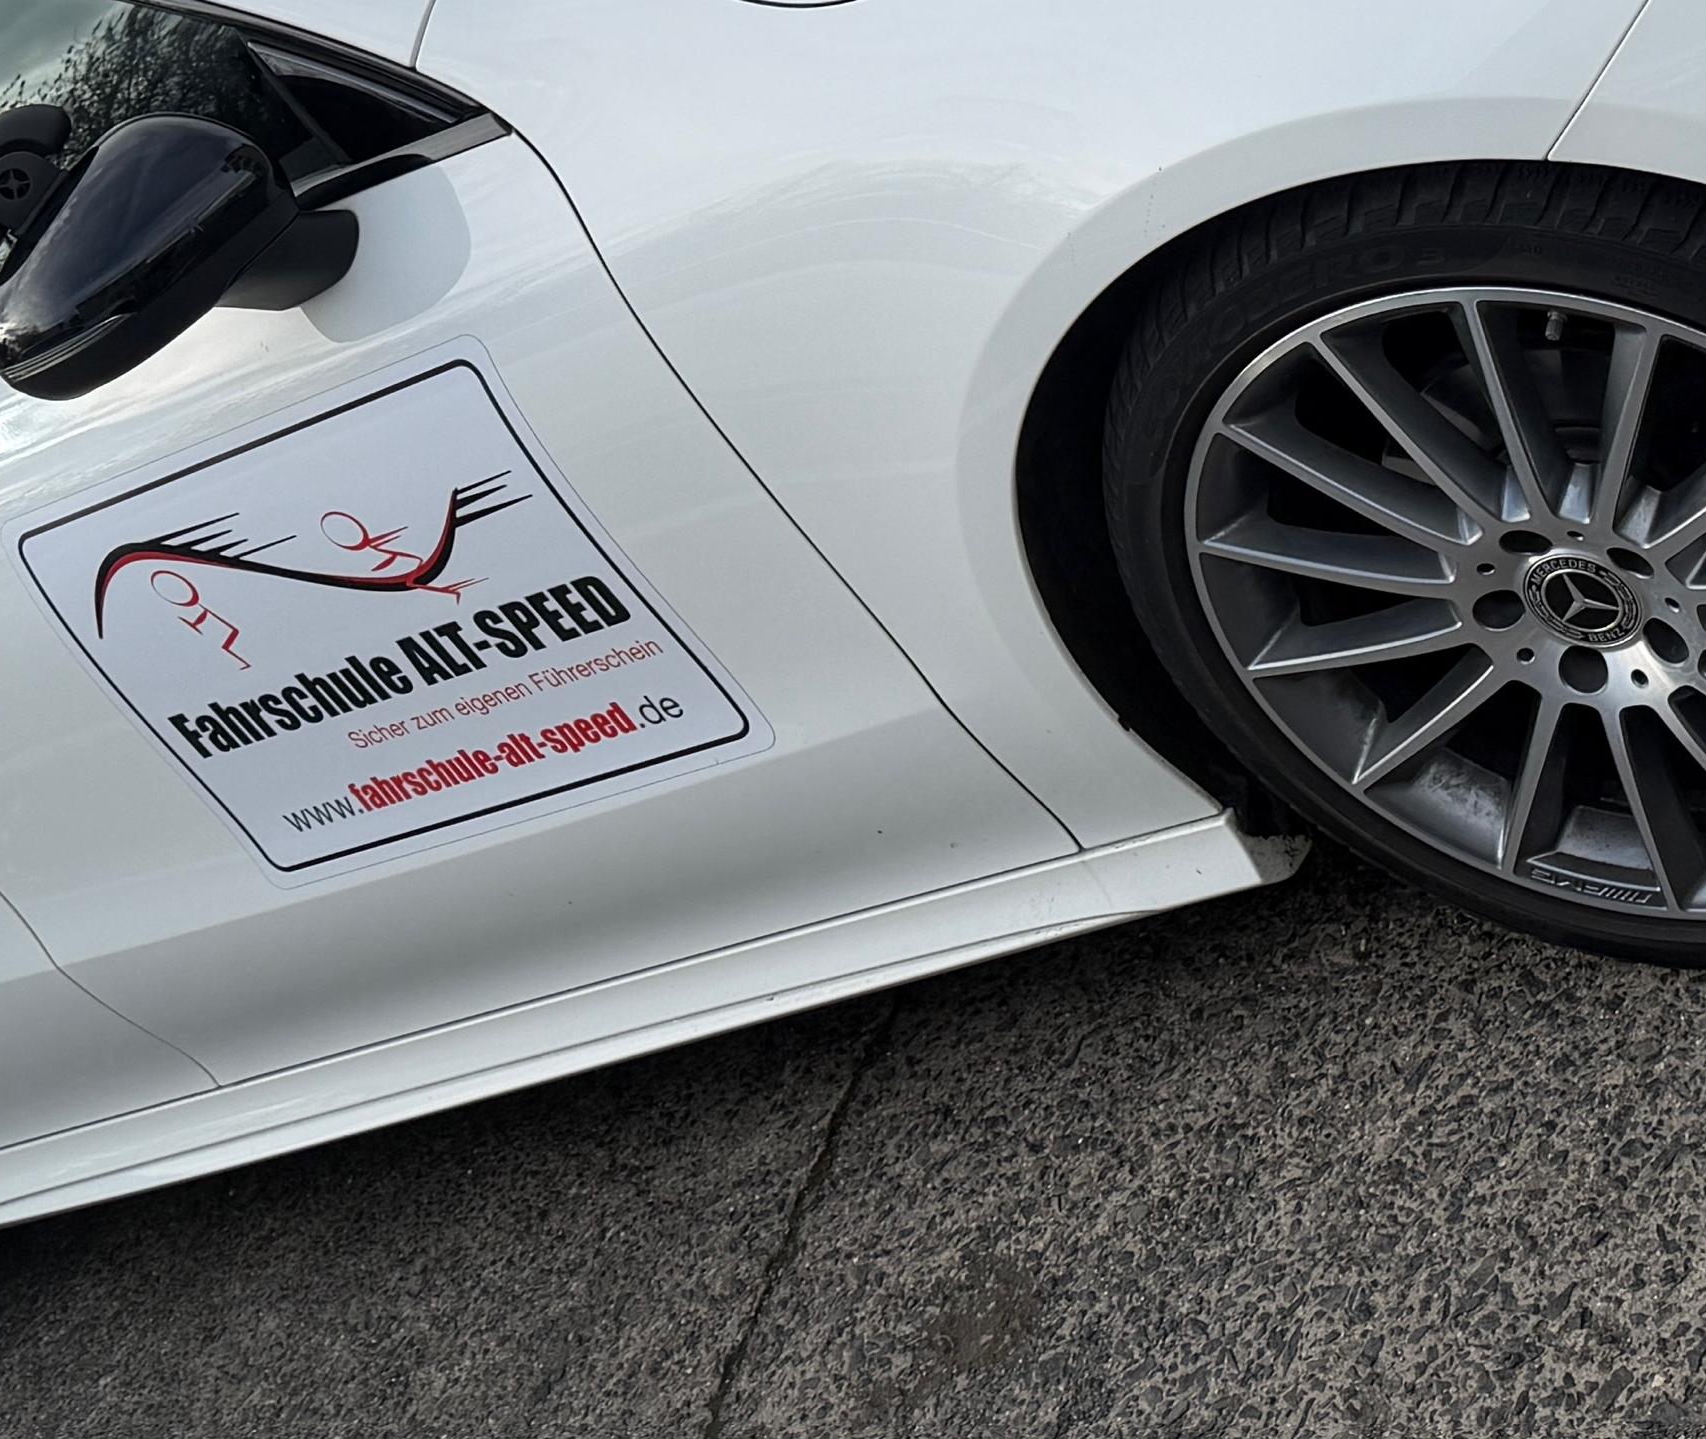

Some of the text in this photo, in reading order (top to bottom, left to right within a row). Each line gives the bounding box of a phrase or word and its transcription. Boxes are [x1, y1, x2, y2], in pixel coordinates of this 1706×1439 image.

[1530, 559, 1597, 586] MERCEDES
[168, 575, 632, 760] Fahrschule ALT-SPEED
[1588, 629, 1625, 642] BENZ
[348, 638, 664, 749] Sicher zum eigenen Führerschein
[282, 695, 684, 833] www.fahrschule-alt-speed.de
